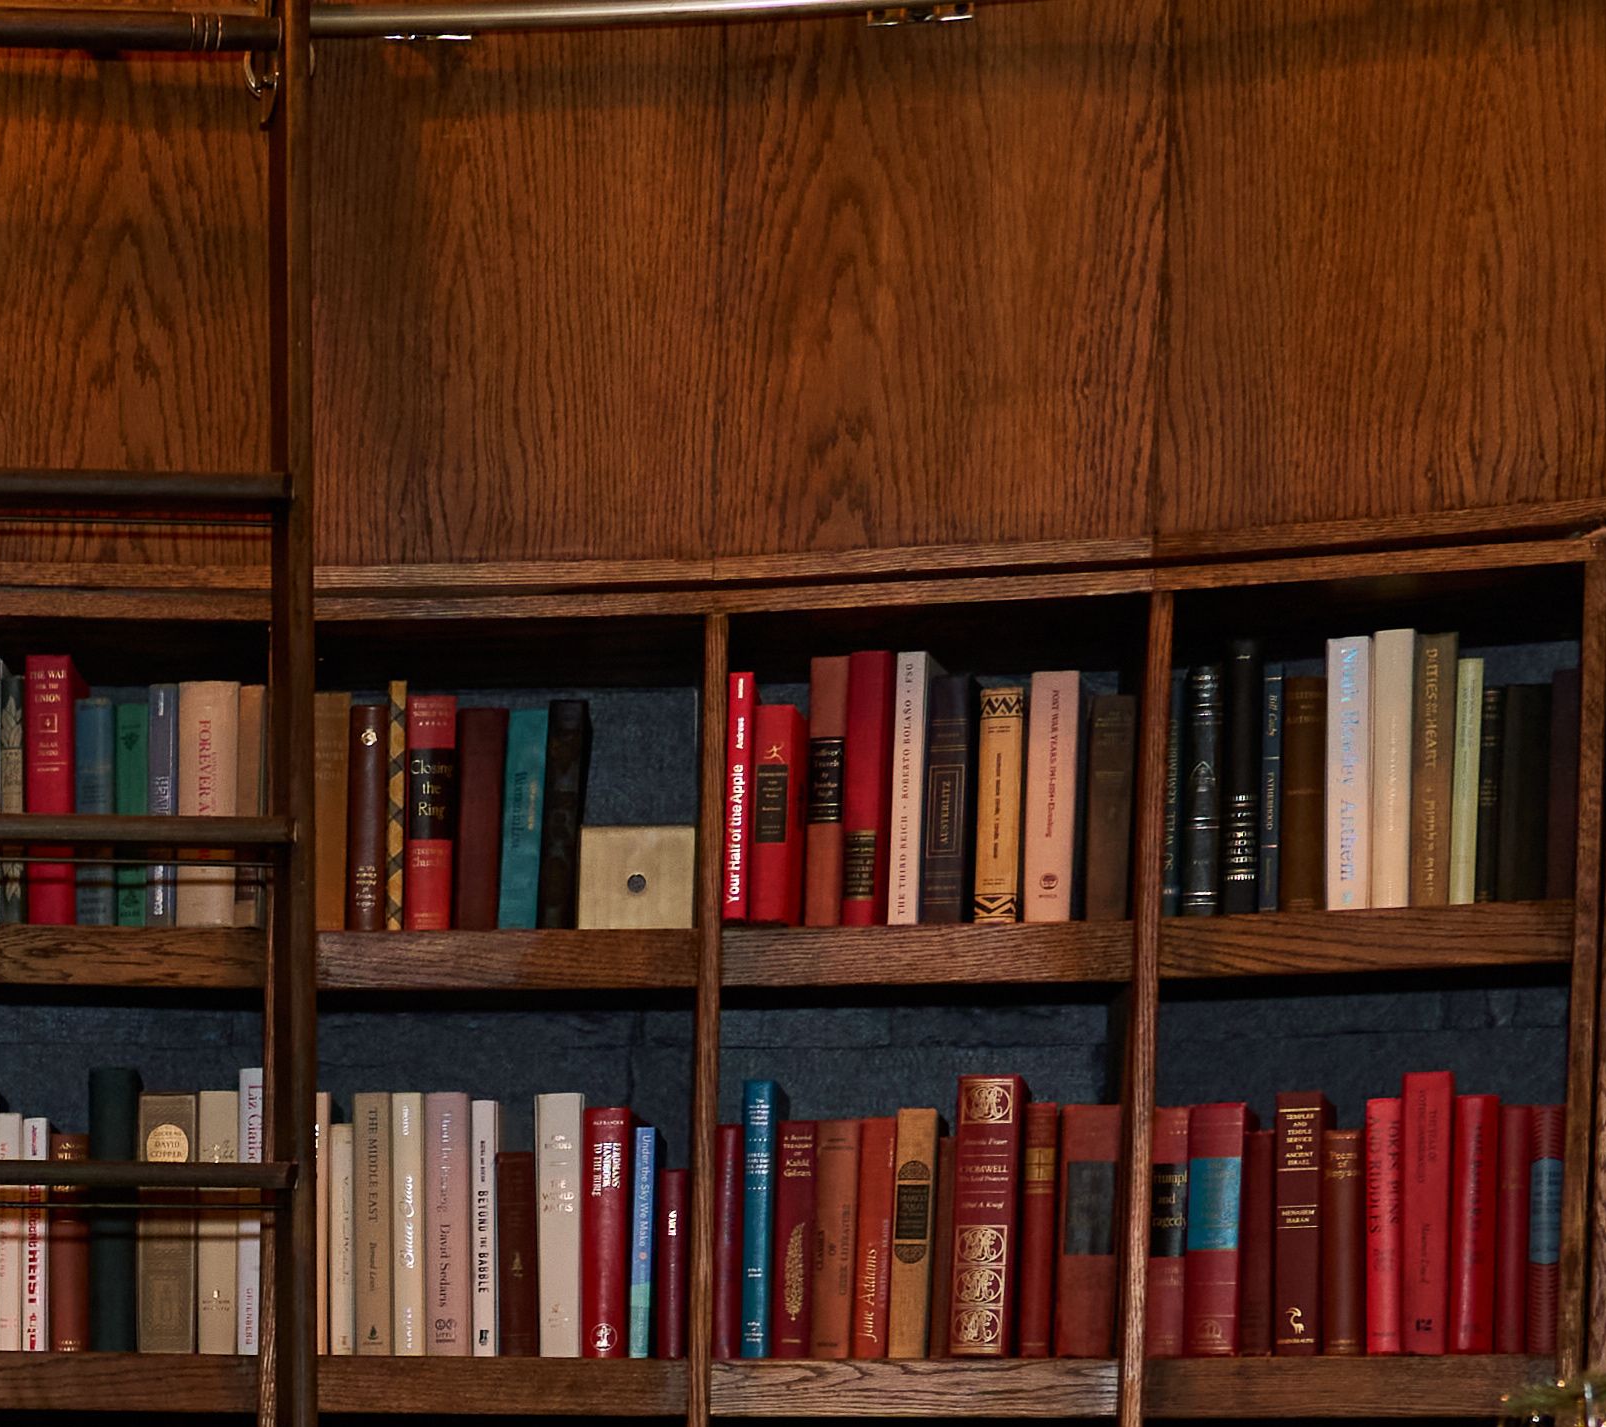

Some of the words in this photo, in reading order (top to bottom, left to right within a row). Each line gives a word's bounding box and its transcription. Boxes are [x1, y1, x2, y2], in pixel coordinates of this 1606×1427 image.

[34, 693, 61, 702] UNION
[903, 699, 912, 745] BOLAÑO
[198, 719, 212, 798] FOREVER
[1426, 715, 1437, 769] HEART
[410, 759, 453, 777] Closing
[732, 764, 744, 804] Apple
[901, 749, 911, 799] ROBERTO
[421, 780, 442, 796] the
[417, 802, 446, 820] Ring
[731, 806, 742, 826] the
[731, 828, 741, 843] of
[899, 815, 907, 849] REICH
[729, 845, 741, 871] Half
[898, 853, 907, 893] THIRD
[727, 873, 740, 902] Your
[897, 897, 906, 916] THE
[368, 1107, 378, 1132] THE
[1369, 1116, 1380, 1151] AND
[1391, 1119, 1401, 1170] JOKES
[367, 1136, 378, 1188] MIDDLE
[784, 1169, 811, 1178] Gibran
[786, 1159, 810, 1168] Kahlil
[367, 1192, 377, 1223] EAST
[478, 1190, 488, 1232] BEYOND
[1368, 1156, 1381, 1234] RIDDLES
[1390, 1180, 1399, 1226] PUNS
[439, 1224, 452, 1257] David
[438, 1262, 450, 1308] Sedaris
[478, 1252, 488, 1294] BABBLE
[860, 1247, 877, 1307] Addams
[857, 1310, 878, 1342] Jane
